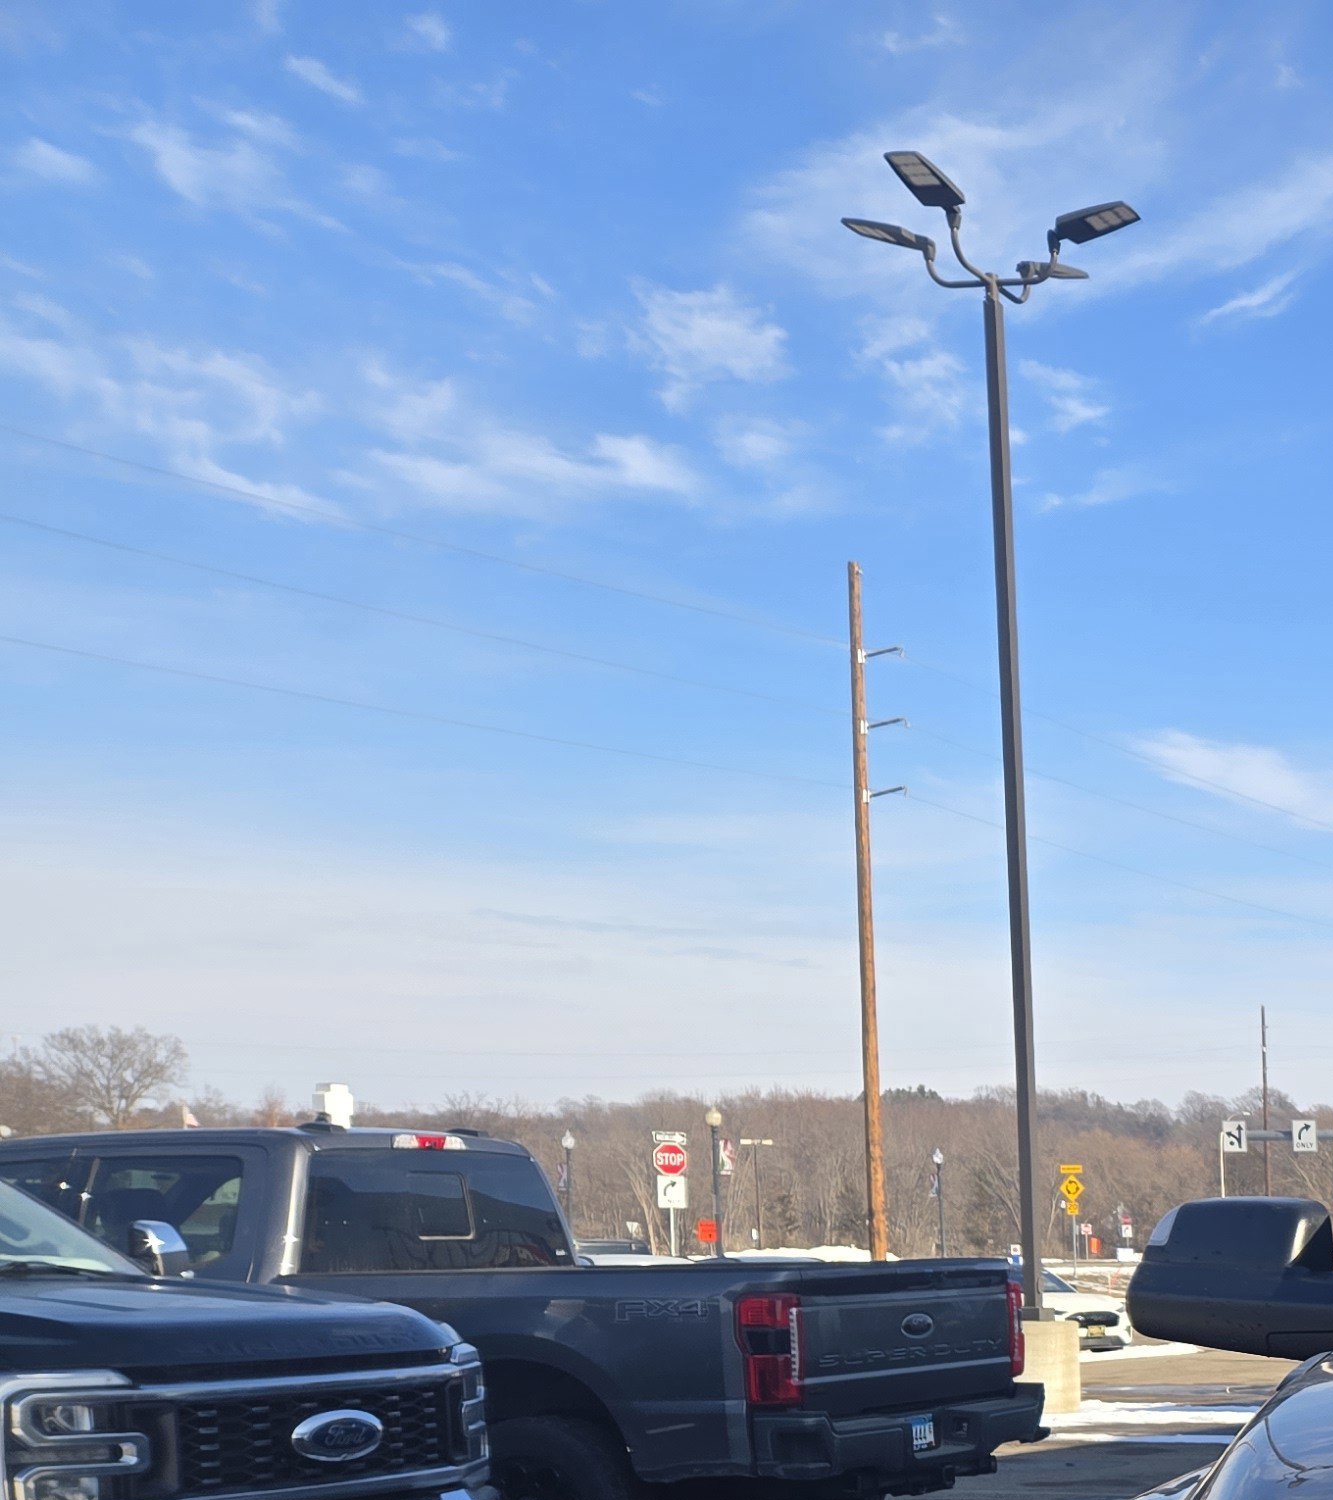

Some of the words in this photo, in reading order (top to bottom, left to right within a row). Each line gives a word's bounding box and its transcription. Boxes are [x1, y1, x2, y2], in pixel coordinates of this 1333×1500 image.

[656, 1152, 685, 1166] STOP
[615, 1299, 708, 1322] FX4
[818, 1345, 927, 1368] SUPER
[934, 1336, 1002, 1356] DUTY
